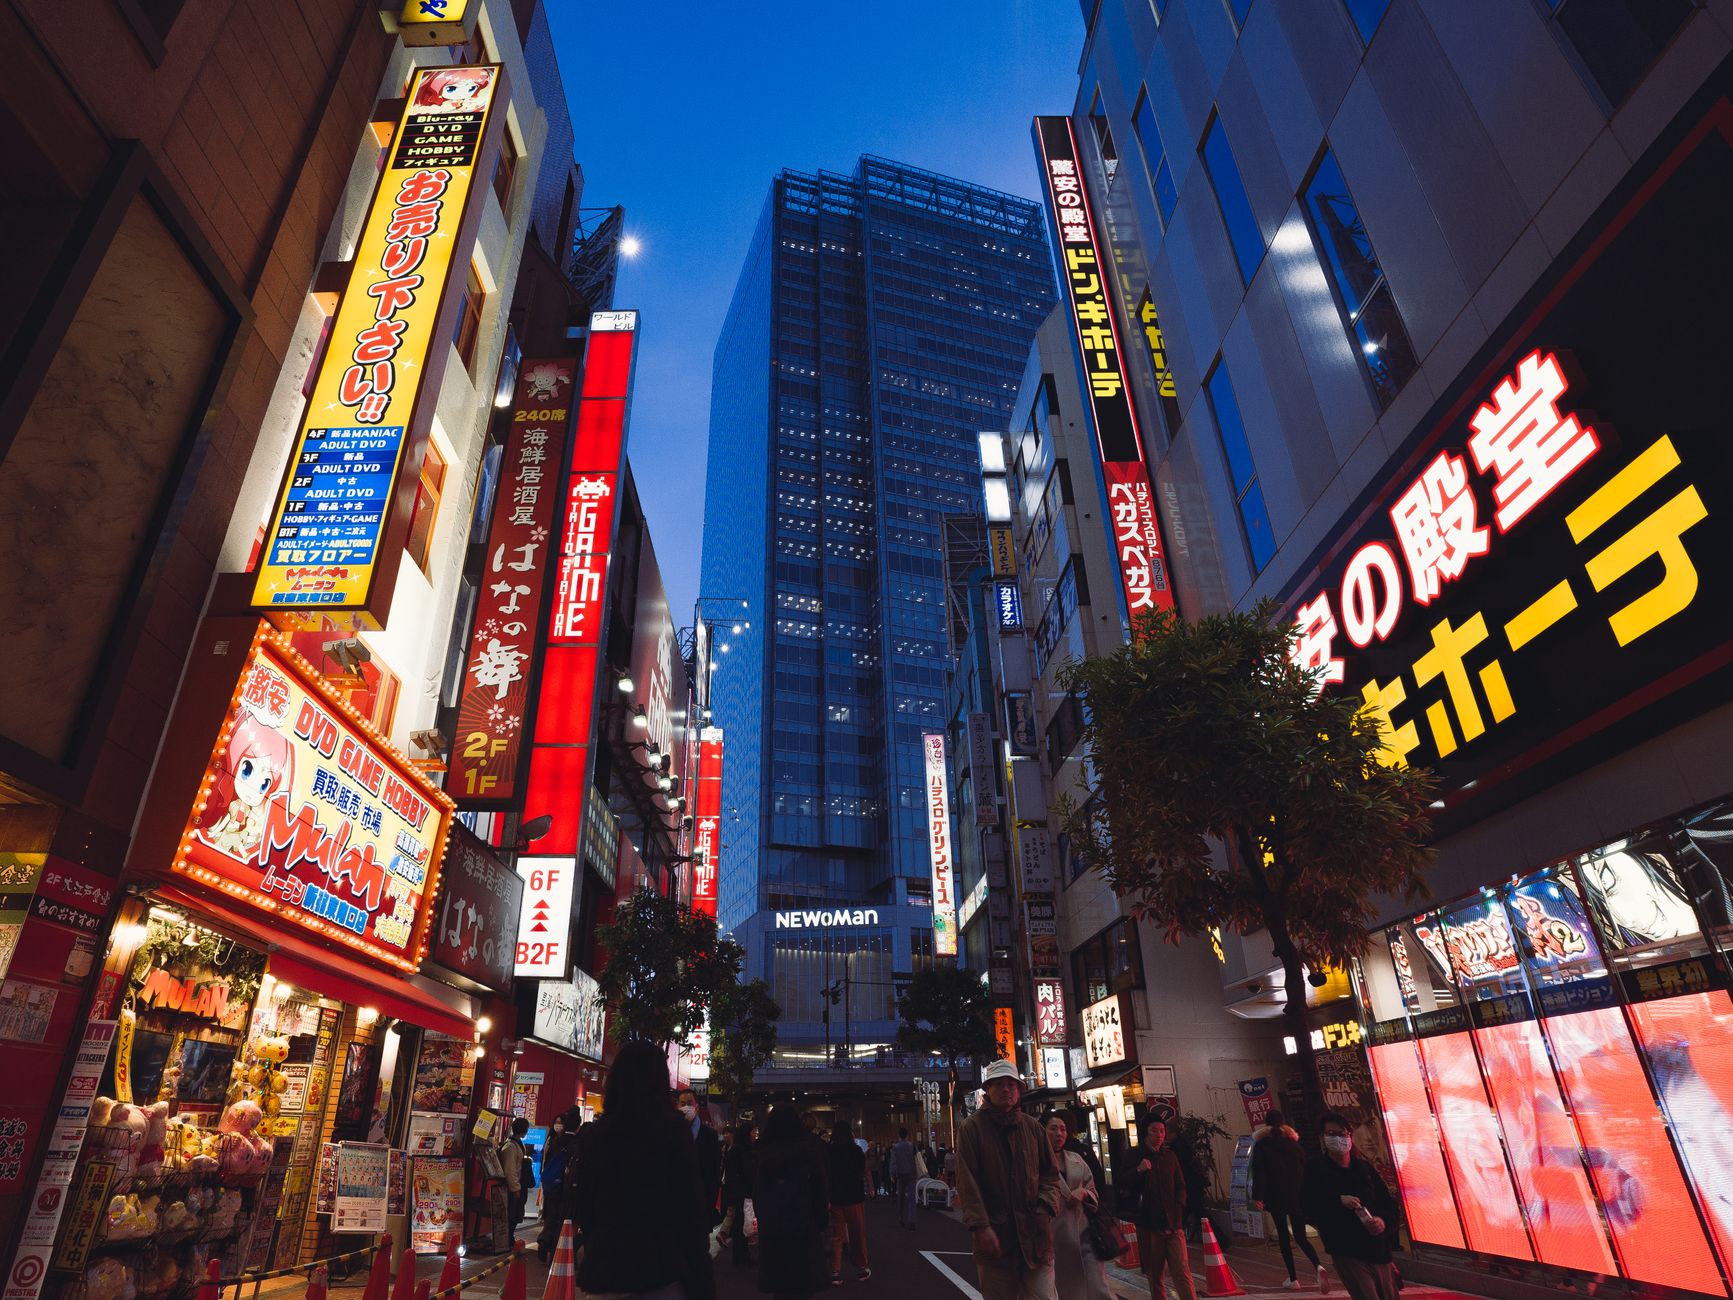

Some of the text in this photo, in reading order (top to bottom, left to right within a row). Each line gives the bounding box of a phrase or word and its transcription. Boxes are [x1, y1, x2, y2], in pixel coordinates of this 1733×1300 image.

[416, 114, 475, 123] Blu-ray
[423, 124, 462, 133] DVD
[407, 146, 464, 155] HOBBY
[414, 135, 463, 144] GAME
[403, 157, 464, 167] フィギュア
[1050, 159, 1090, 242] 驚安の殿堂
[593, 313, 632, 321] ワールド
[514, 409, 567, 422] 240席
[308, 429, 326, 439] 4F
[318, 440, 387, 449] ADULT DVD
[302, 452, 364, 463] 3F 新品
[312, 464, 380, 473] ADULT DVD
[294, 476, 357, 487] 2F 中古
[508, 427, 549, 526] 海鮮居酒屋
[305, 488, 374, 498] ADULT DVD
[288, 502, 304, 512] 1F
[278, 527, 298, 538] B1F
[275, 549, 367, 563] 買取フロアー
[1111, 483, 1154, 609] ベガスベガス
[291, 581, 336, 591] ムーラン
[553, 558, 573, 637] STATION
[1000, 586, 1014, 620] カラオケ
[469, 543, 540, 701] はなの舞
[463, 732, 509, 758] 2F
[293, 697, 431, 832] DVD GAME HOBBY
[464, 768, 498, 794] 1F
[336, 784, 363, 818] 販売
[360, 803, 384, 837] 市場
[257, 790, 388, 912] Mulan
[933, 821, 950, 905] グリンピース
[0, 863, 35, 886] 食堂
[46, 872, 63, 886] 2F
[259, 864, 306, 906] ムーラン
[462, 847, 514, 907] 海鮮居酒屋
[529, 869, 560, 891] 6F
[37, 897, 101, 931] 旬のおすすめ!
[515, 942, 559, 965] B2F
[138, 966, 230, 1018] MULAN
[1038, 982, 1058, 1035] 肉バル
[1322, 1019, 1361, 1050] ドンキ
[1247, 1099, 1273, 1113] 銀行
[4, 1288, 38, 1298] PRESTIGE
